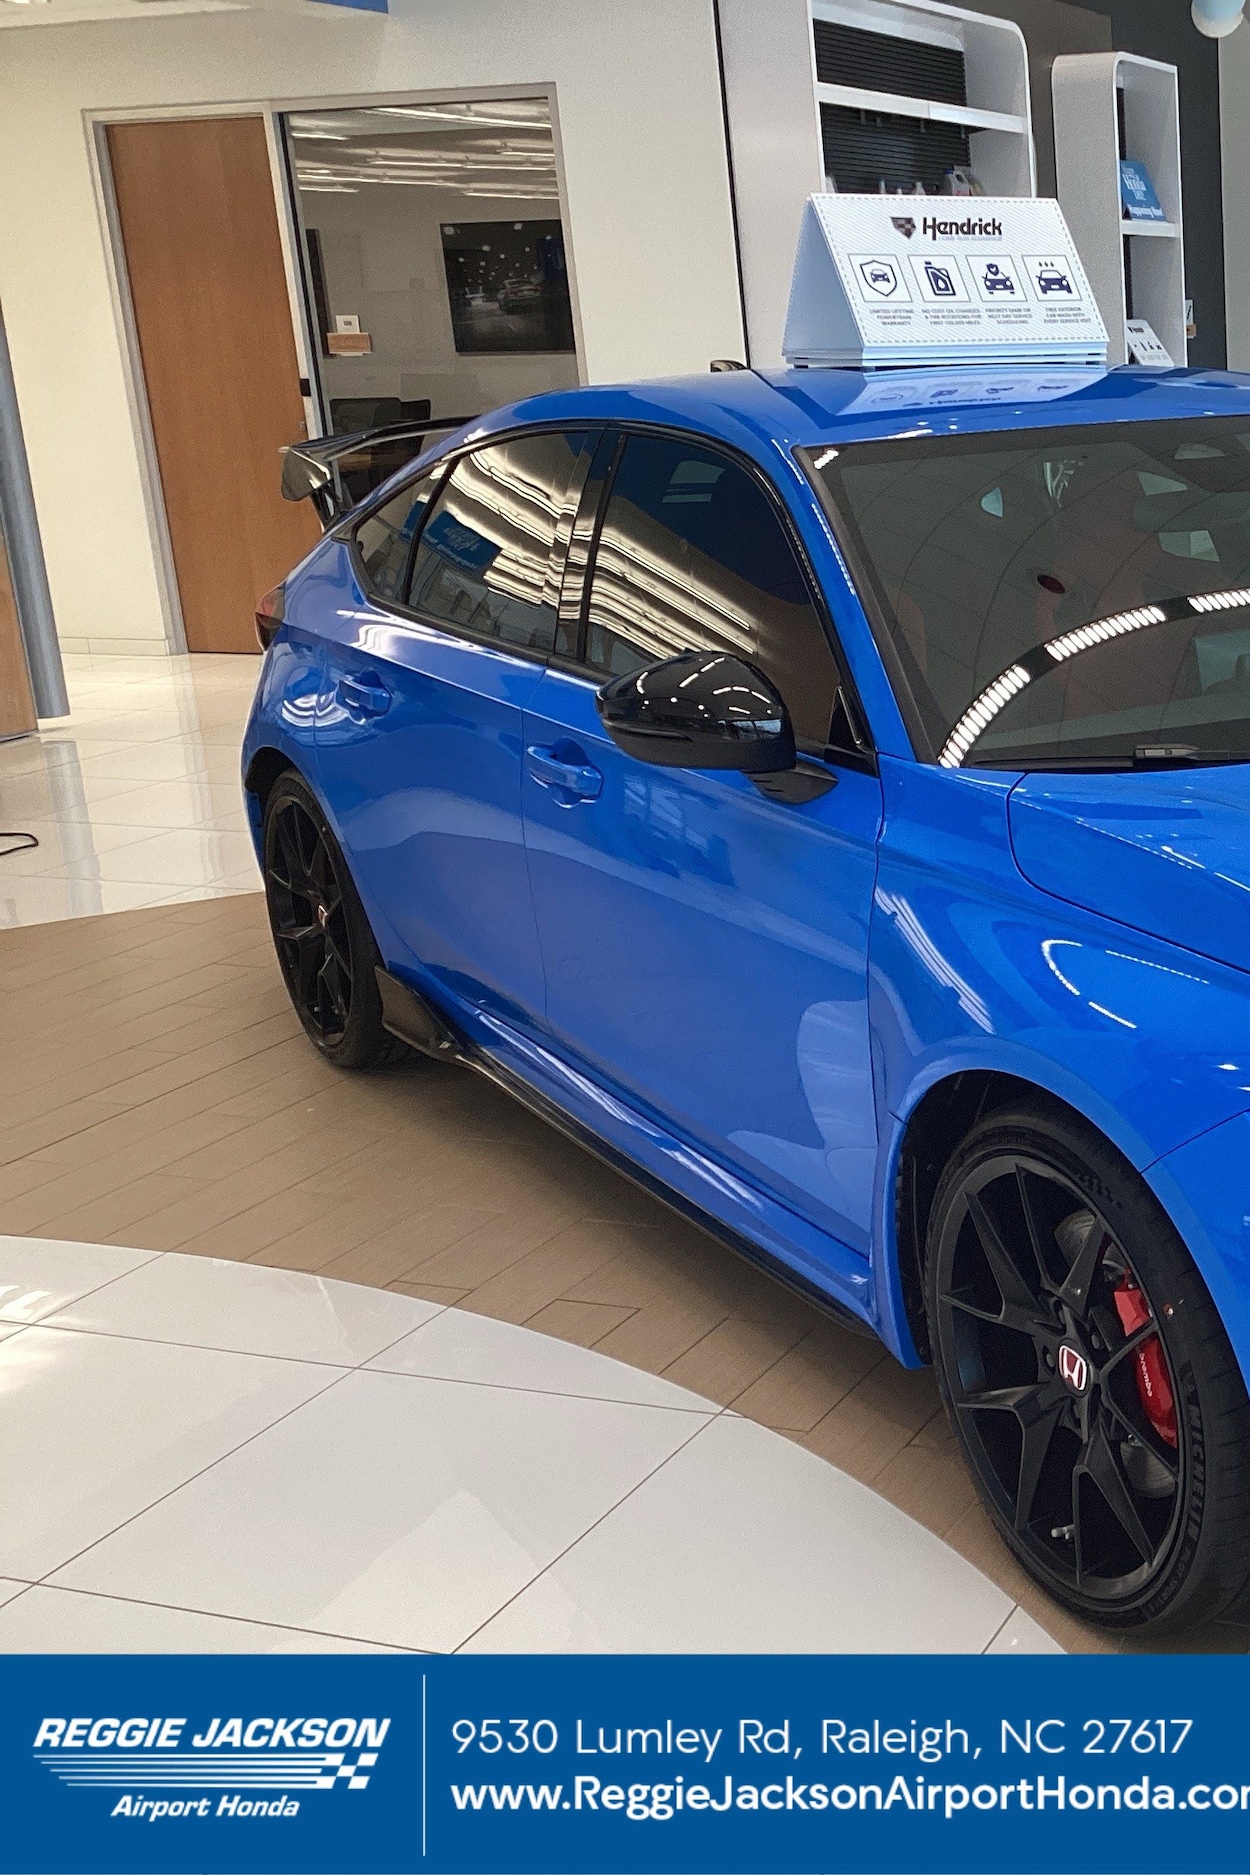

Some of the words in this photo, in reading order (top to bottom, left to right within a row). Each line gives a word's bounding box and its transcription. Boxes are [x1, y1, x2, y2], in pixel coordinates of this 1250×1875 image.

[922, 217, 1002, 241] Hendrick
[1139, 1352, 1154, 1398] brembo
[1186, 1402, 1204, 1543] MICHELIN
